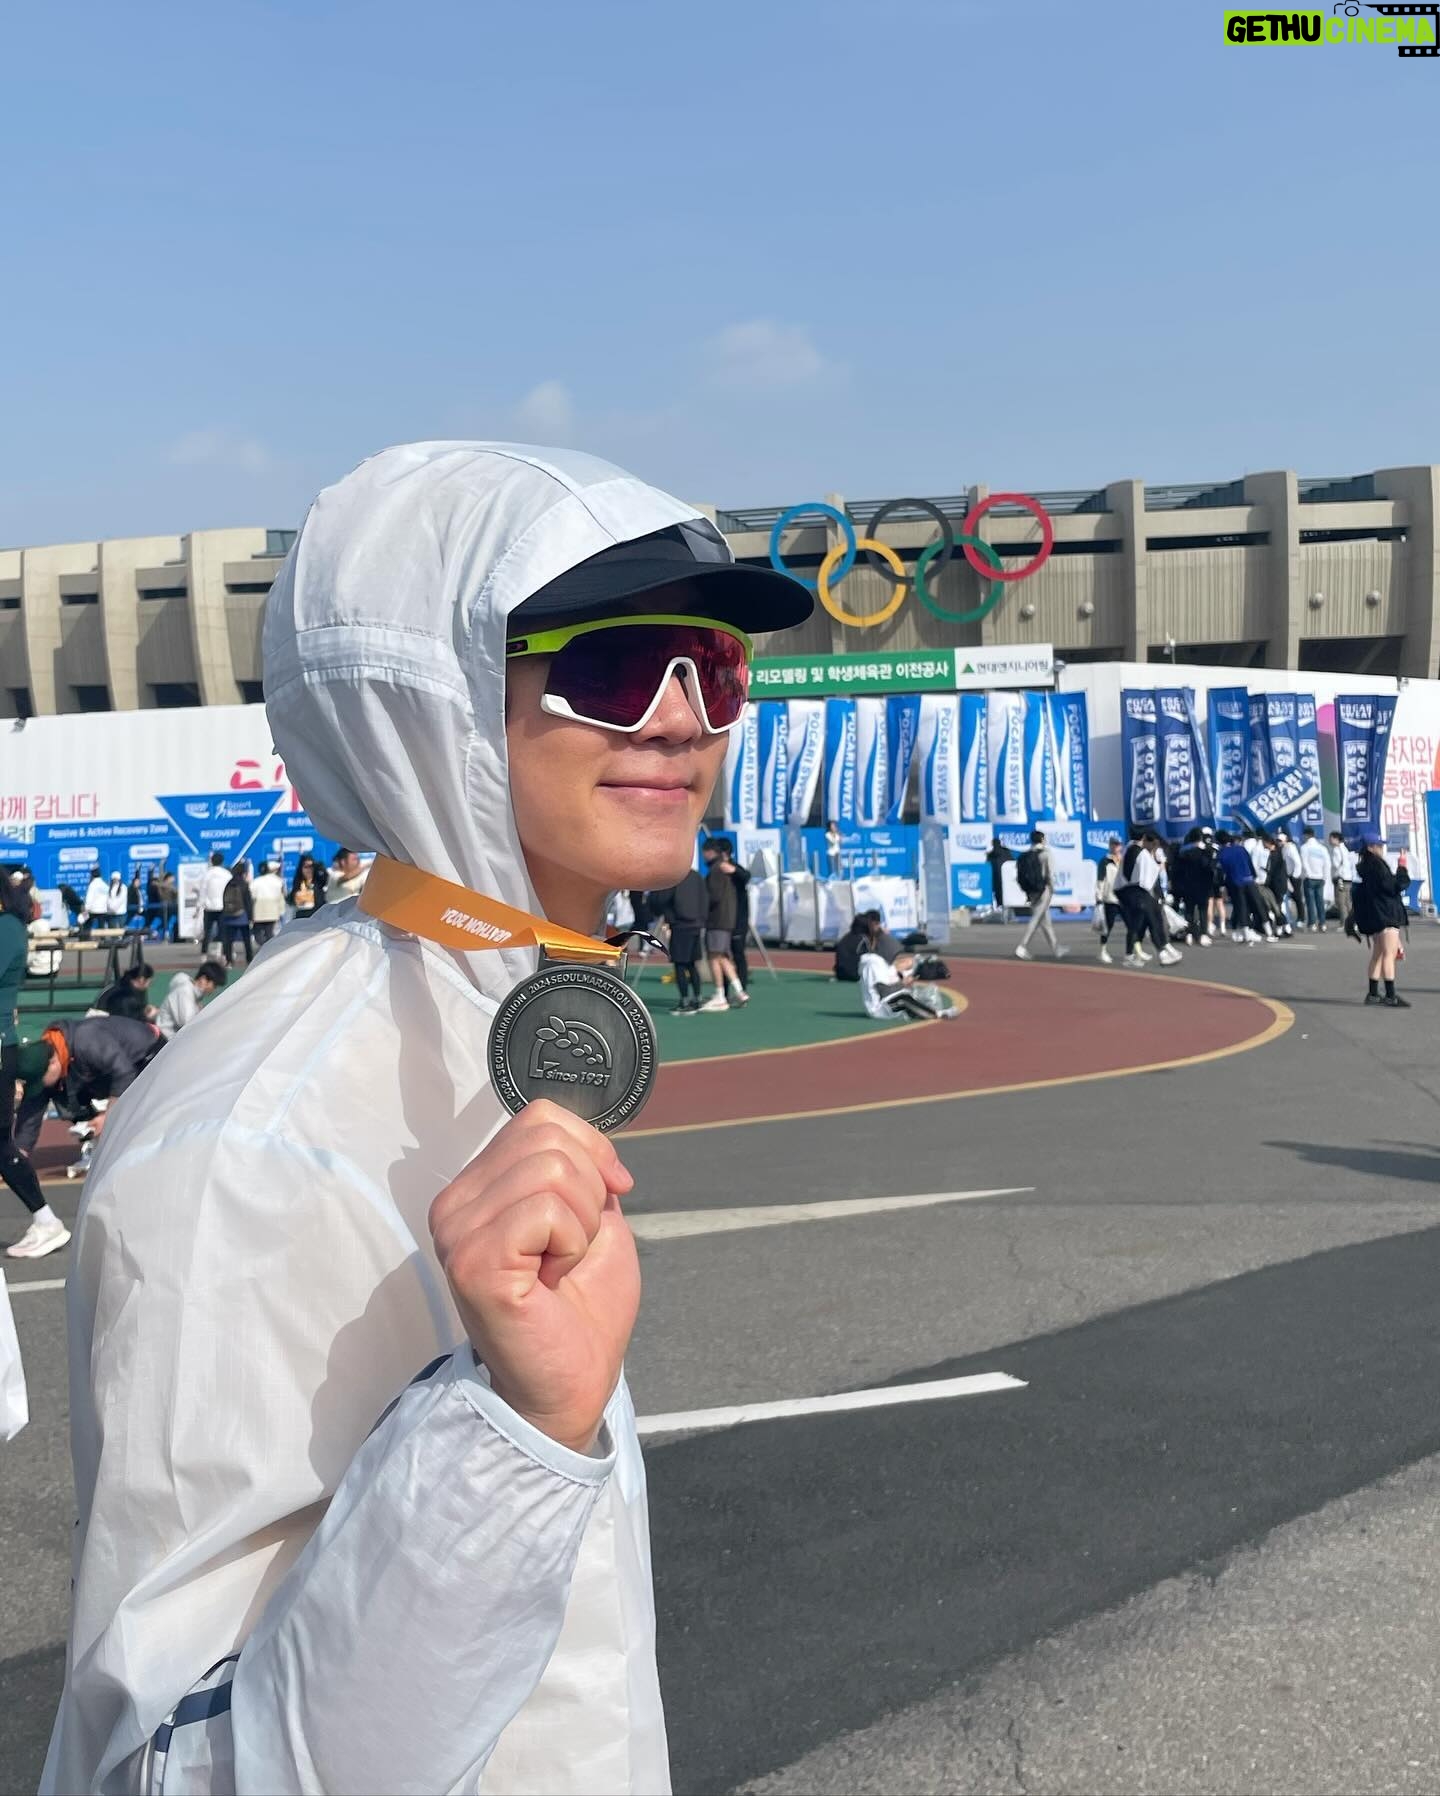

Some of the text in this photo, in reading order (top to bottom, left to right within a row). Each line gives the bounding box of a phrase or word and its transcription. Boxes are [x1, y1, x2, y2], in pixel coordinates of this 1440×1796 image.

[756, 667, 807, 685] 리모델링
[811, 666, 824, 683] 및
[828, 663, 892, 682] 학생체육관
[895, 661, 949, 679] 이전공사
[803, 711, 820, 762] POCARI
[845, 711, 857, 770] POCARI
[901, 708, 912, 769] POCAR
[1067, 703, 1083, 761] POCARI
[744, 716, 756, 821] POCARI SWEAT
[937, 706, 951, 818] POCARI SWEAT
[1009, 705, 1022, 817] POCARI SWEAT
[1178, 738, 1190, 816] POCARI
[1231, 735, 1242, 806] POCAR
[1356, 743, 1367, 817] POCARI
[34, 792, 100, 820] 갑니다
[842, 771, 854, 820] SWEAT
[1072, 762, 1086, 815] SWEAT
[1248, 769, 1303, 811] POCARI
[1256, 780, 1304, 821] SWEAT
[440, 907, 470, 929] 2024
[529, 973, 630, 1007] 2024SEOULMARATHON
[545, 1069, 612, 1088] since 1931
